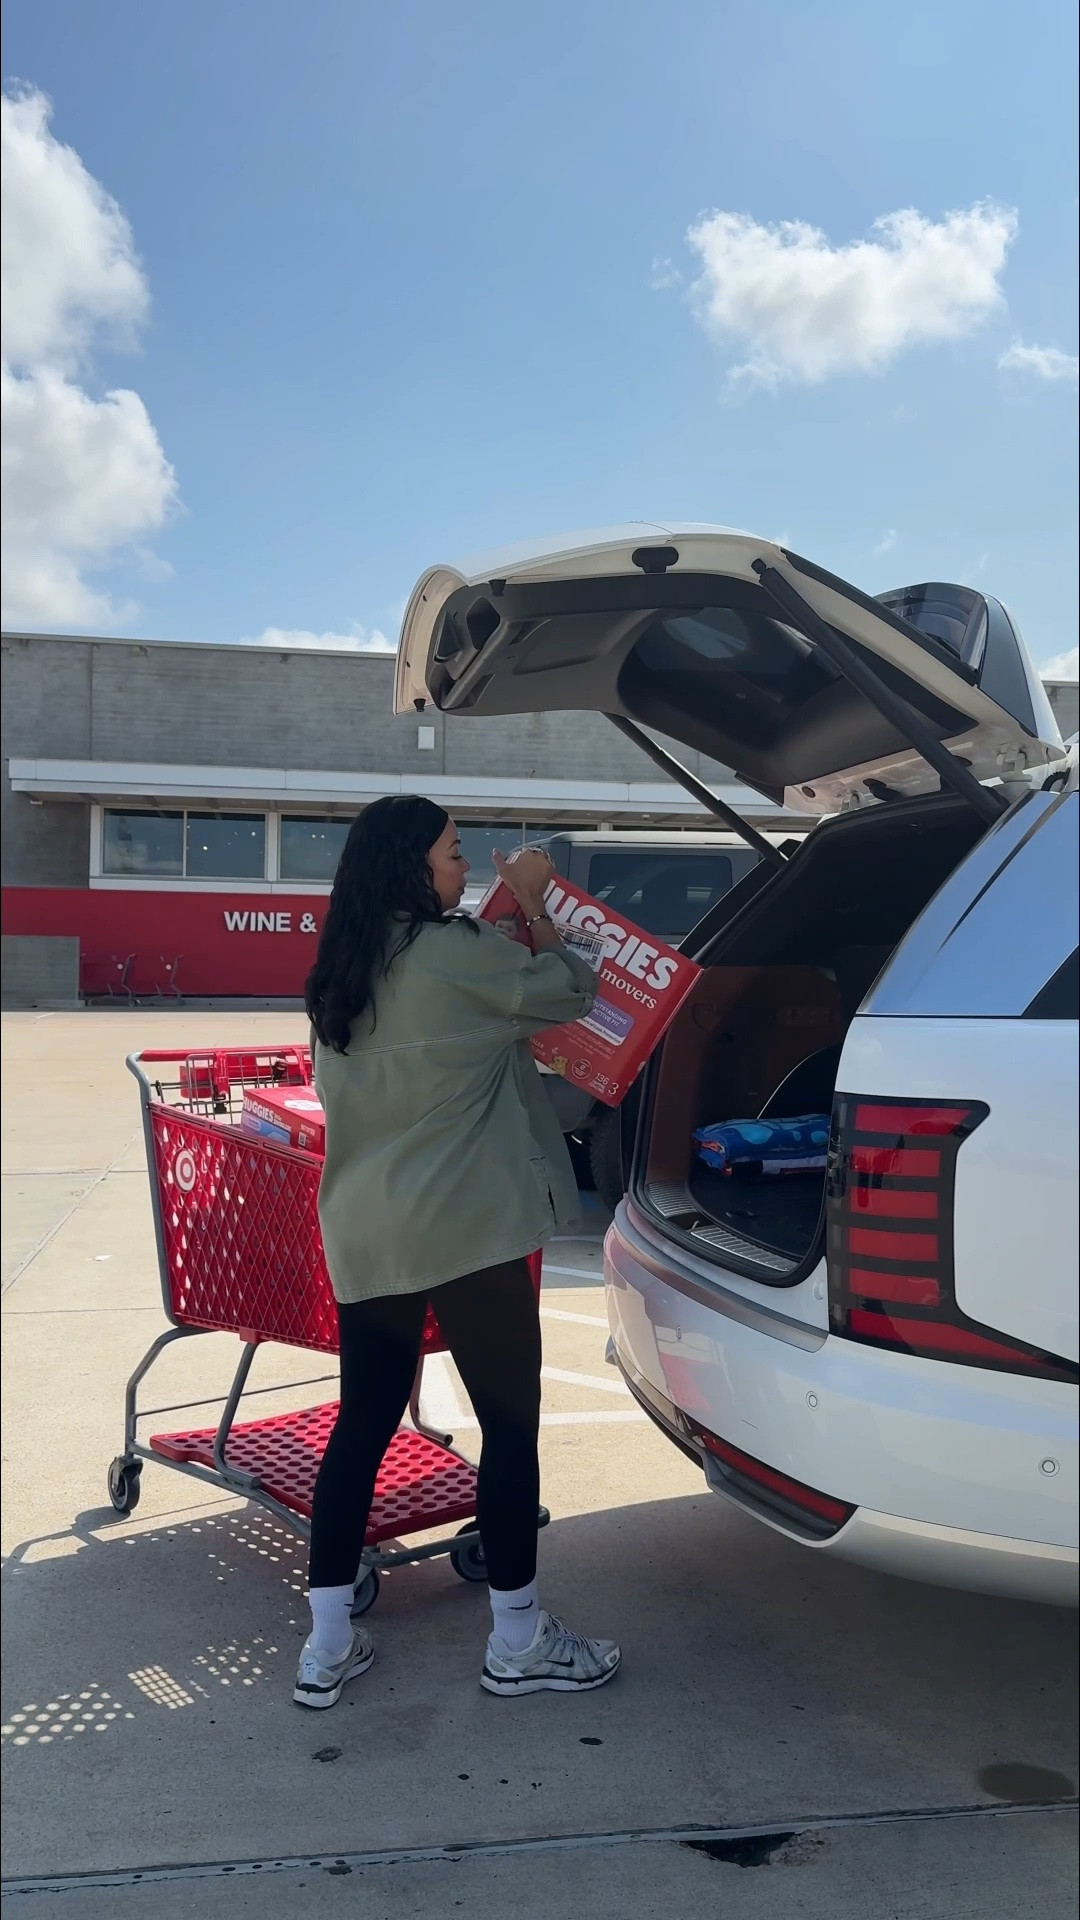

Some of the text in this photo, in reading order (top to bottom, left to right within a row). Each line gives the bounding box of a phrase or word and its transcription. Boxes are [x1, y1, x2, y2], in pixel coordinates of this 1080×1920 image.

[223, 911, 318, 933] WINE &
[600, 968, 658, 1009] movers
[593, 1008, 620, 1027] ACTIVE FIT
[595, 1073, 610, 1086] 136
[608, 1083, 619, 1095] 3
[243, 1096, 275, 1124] HUGGIES
